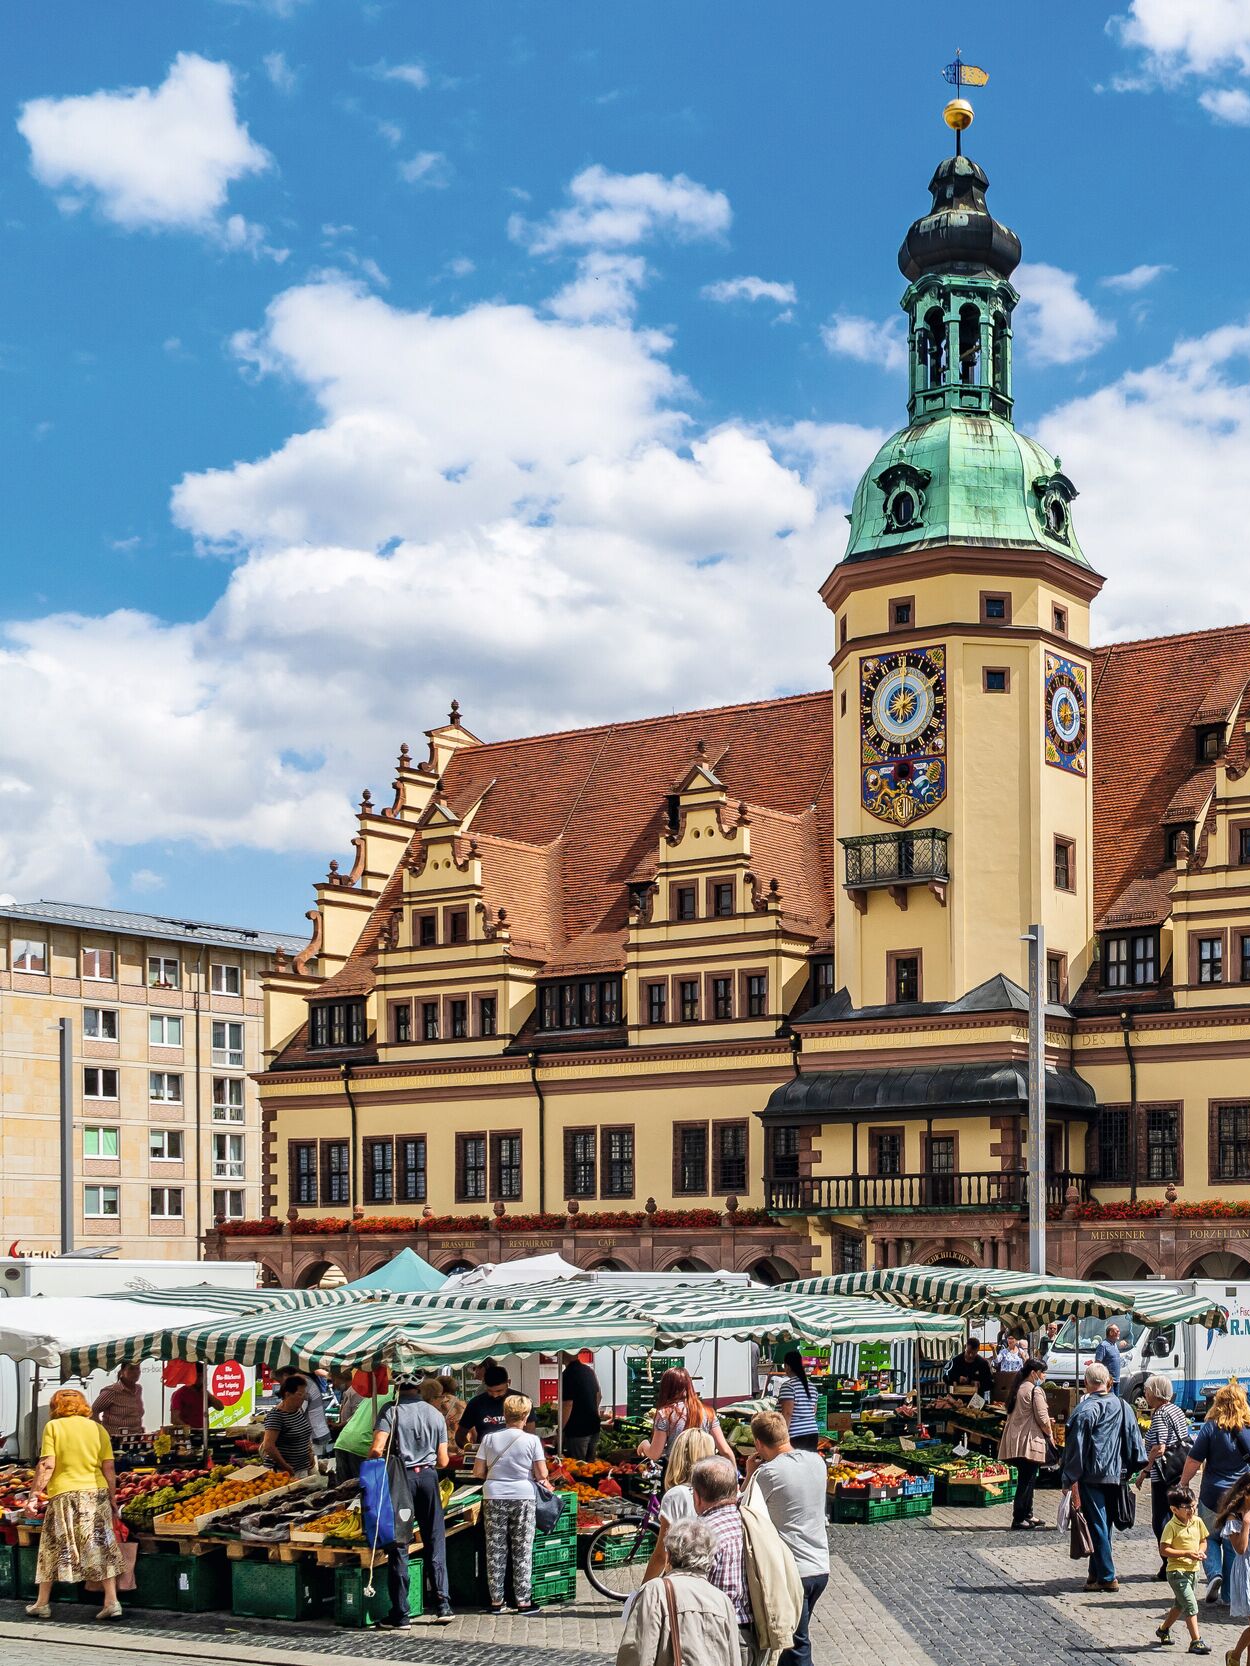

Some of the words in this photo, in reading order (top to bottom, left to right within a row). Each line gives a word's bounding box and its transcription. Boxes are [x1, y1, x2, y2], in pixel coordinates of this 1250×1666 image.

[1081, 1033, 1105, 1046] DES
[1090, 1229, 1146, 1241] MEISSENER
[1189, 1228, 1250, 1240] PORZELLAN
[441, 1240, 476, 1249] BRASSERIE
[509, 1239, 554, 1248] RESTAURANT
